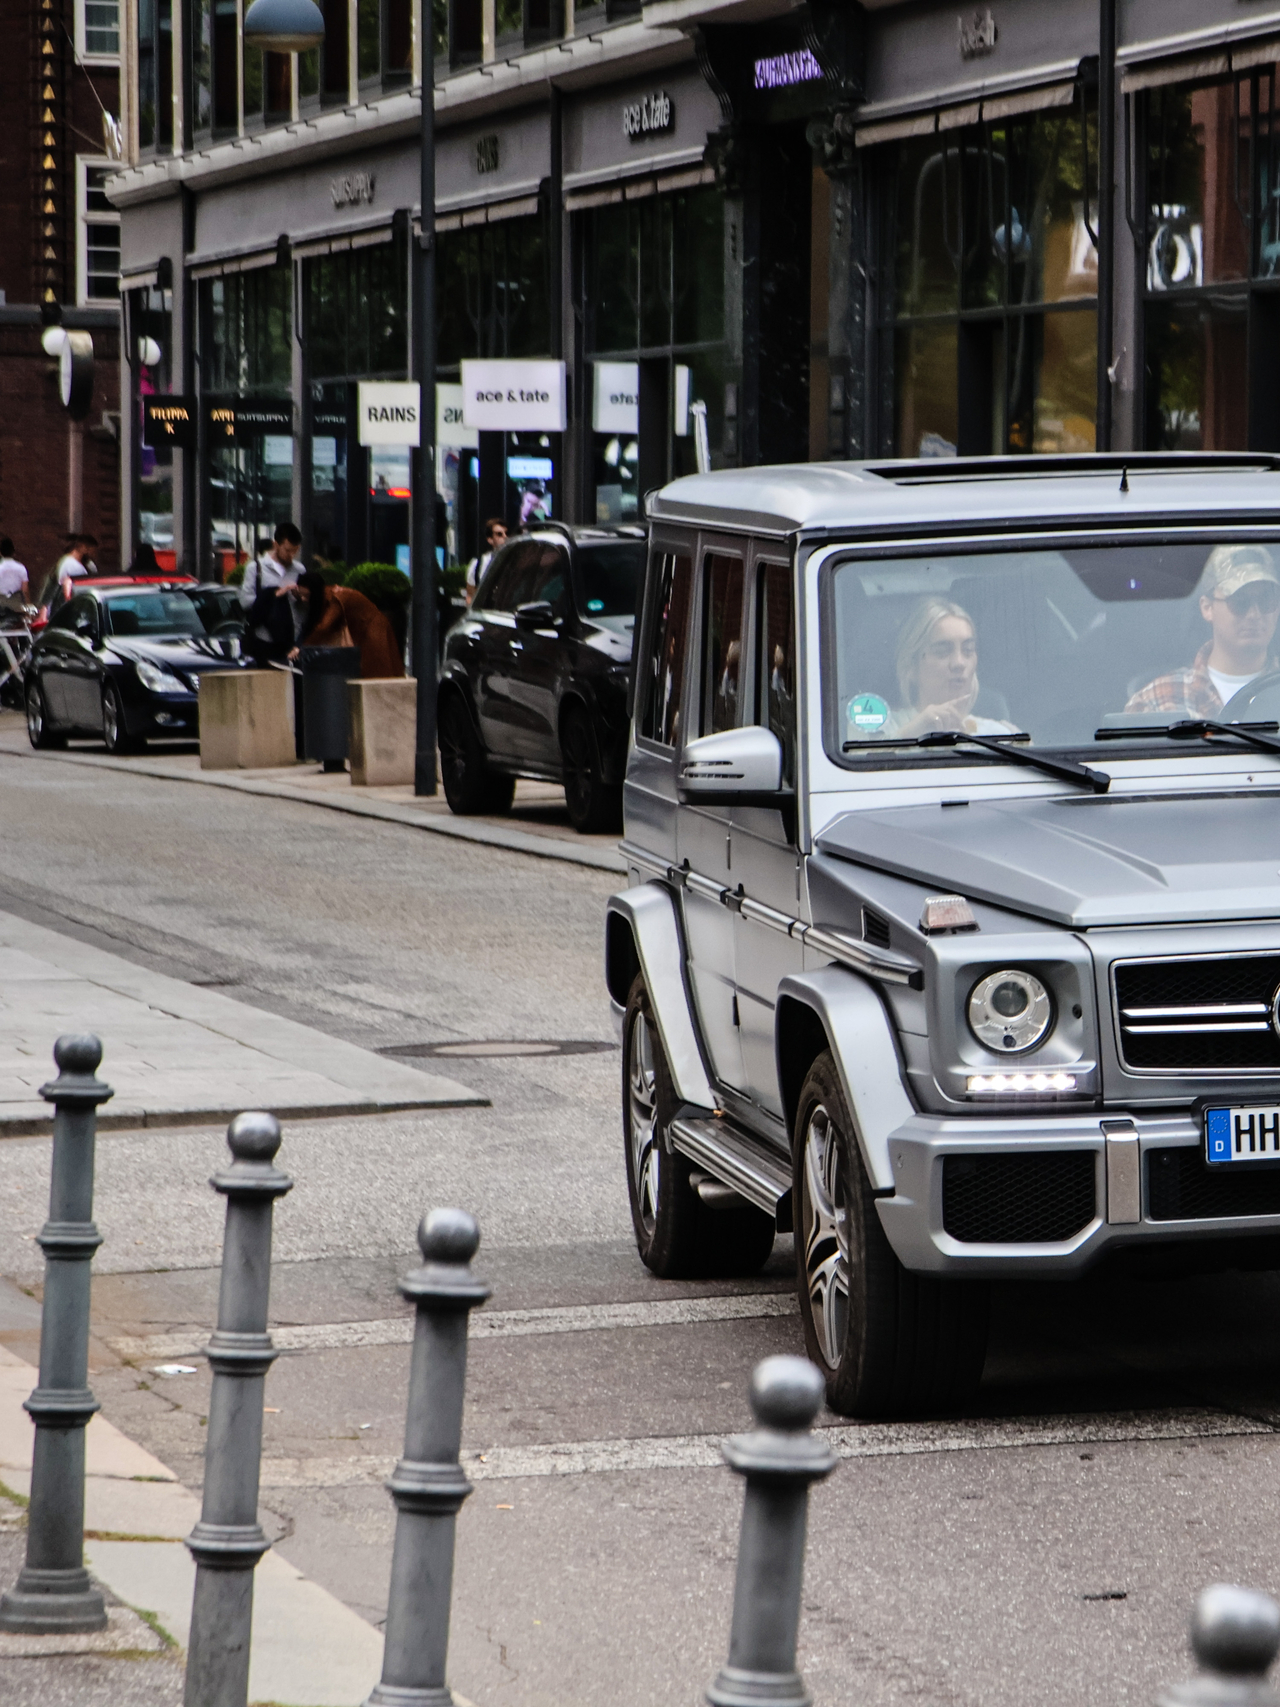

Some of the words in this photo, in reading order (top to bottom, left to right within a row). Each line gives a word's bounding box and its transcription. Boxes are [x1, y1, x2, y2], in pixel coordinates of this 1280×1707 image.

[623, 104, 641, 135] ace
[650, 90, 670, 129] tate
[476, 390, 504, 403] ace
[506, 390, 519, 403] &
[519, 389, 550, 403] tate
[150, 407, 190, 421] FILIPPA
[236, 413, 290, 423] SUITSUPPLY
[367, 406, 417, 423] RAINS
[164, 422, 175, 435] K
[1215, 1140, 1225, 1152] D
[1234, 1112, 1280, 1153] HH
